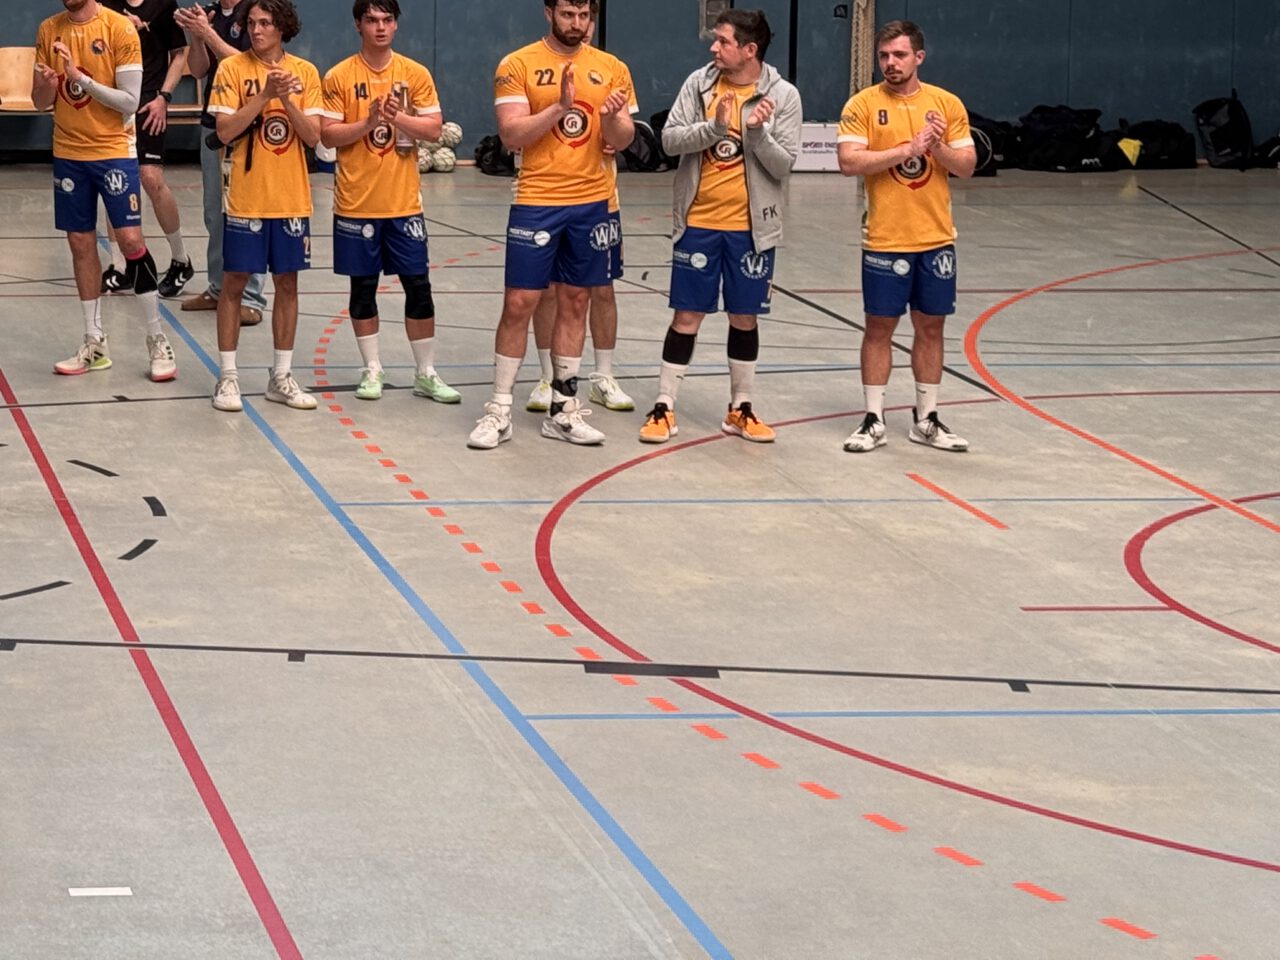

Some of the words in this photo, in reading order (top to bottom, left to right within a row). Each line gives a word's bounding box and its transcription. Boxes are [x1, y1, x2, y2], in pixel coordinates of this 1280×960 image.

[534, 68, 556, 86] 22
[244, 78, 261, 98] 21
[354, 82, 370, 100] 14
[128, 193, 138, 212] 8
[762, 204, 779, 222] FK
